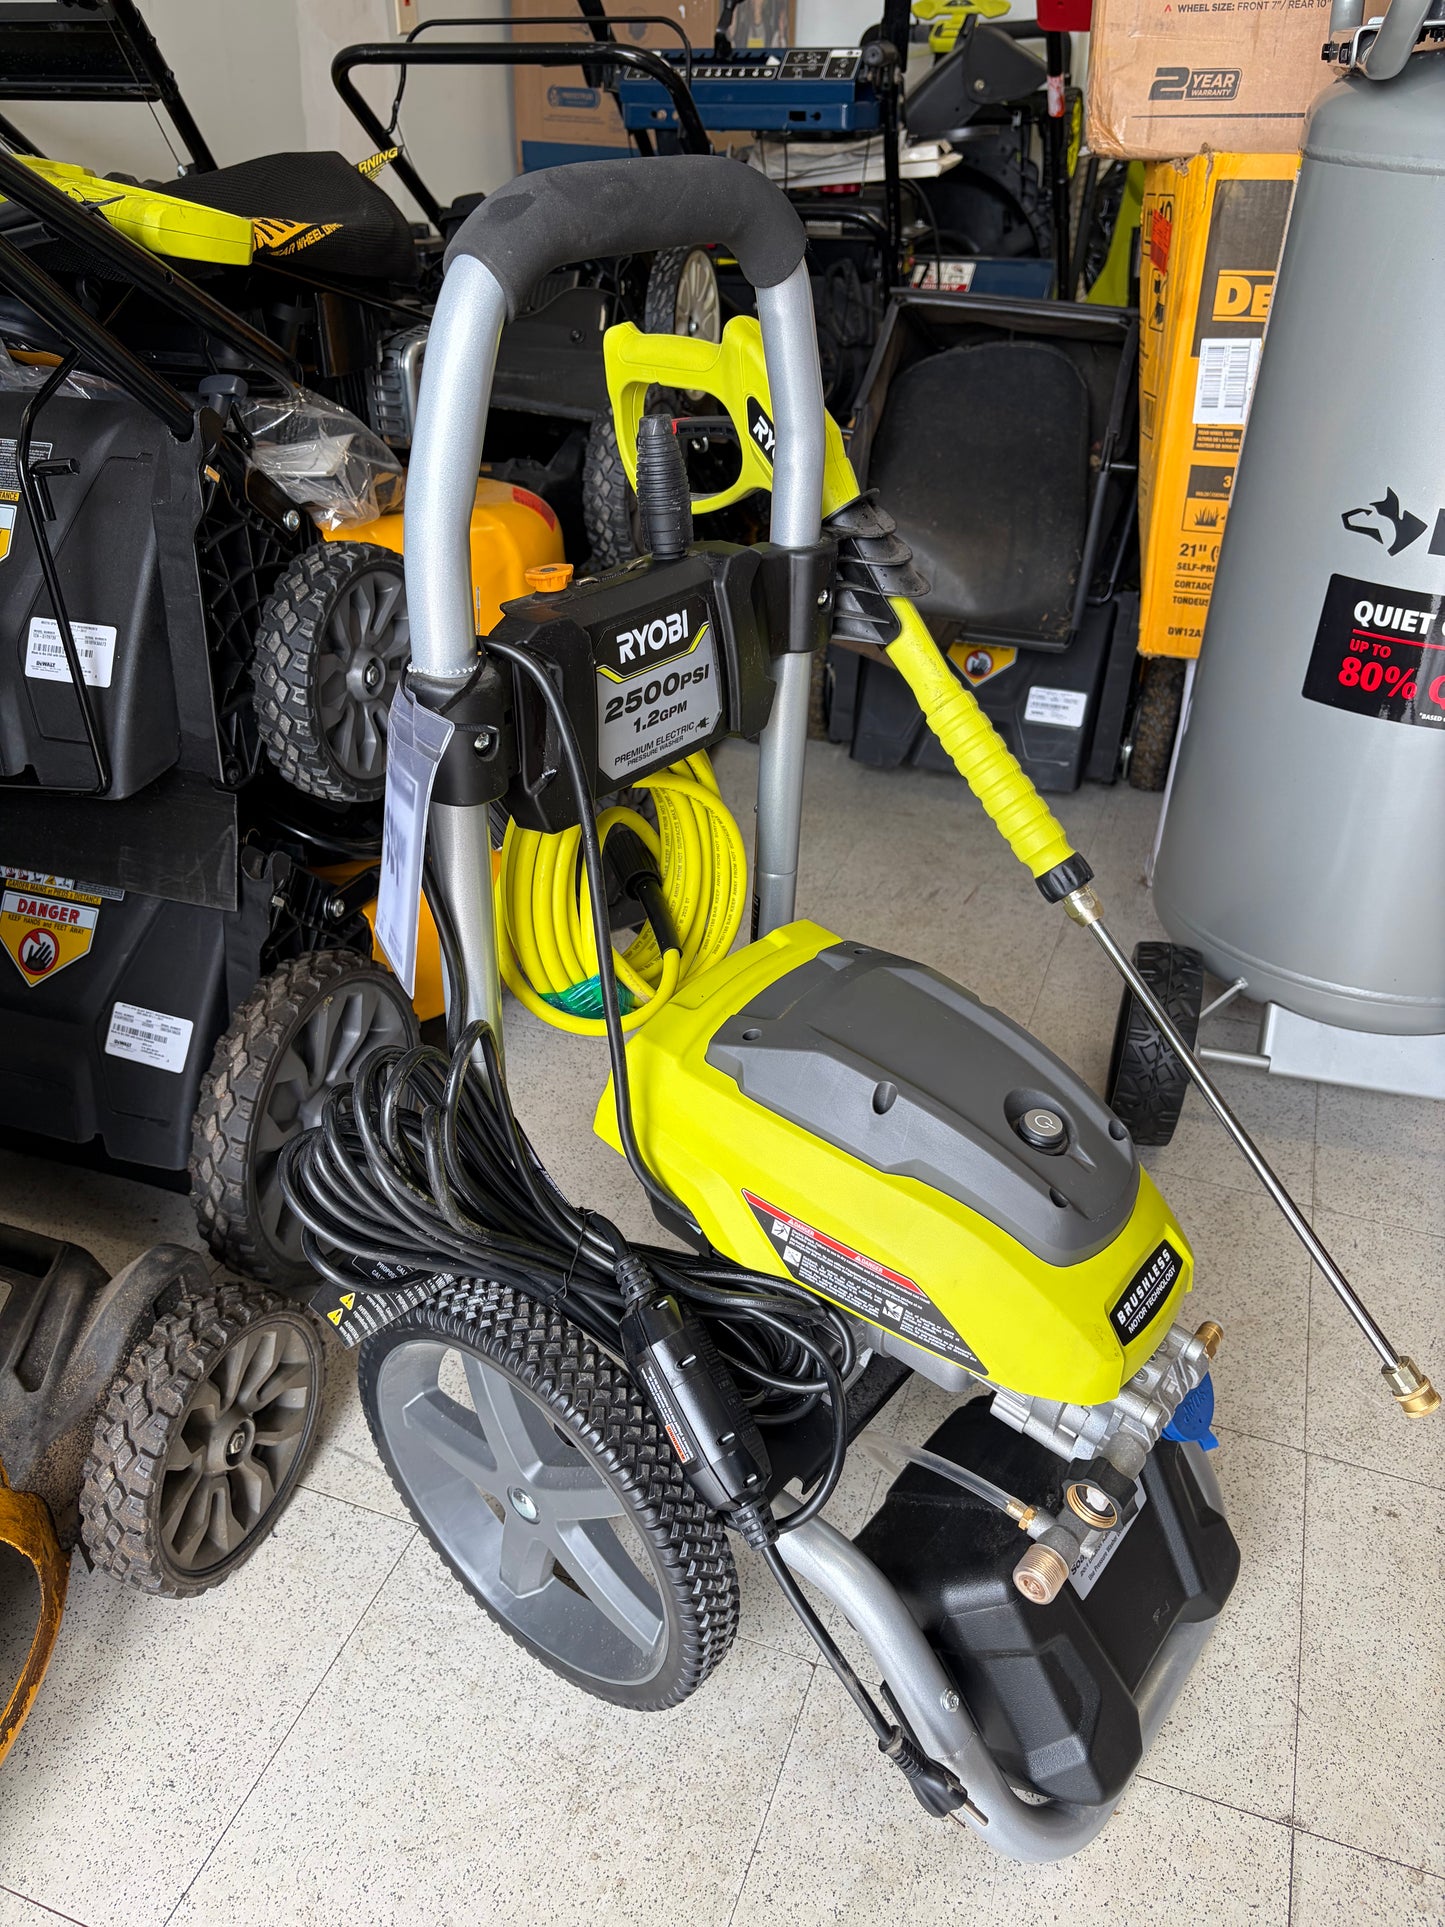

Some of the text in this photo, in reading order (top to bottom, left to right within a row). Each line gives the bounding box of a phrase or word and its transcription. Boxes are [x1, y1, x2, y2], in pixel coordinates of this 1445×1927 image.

[1178, 4, 1209, 14] WHEEL
[1212, 3, 1235, 12] SIZE:
[1237, 2, 1268, 11] FRONT
[1288, 0, 1314, 9] REAR
[1148, 67, 1236, 100] 2 YEAR
[1191, 89, 1232, 97] WARRANTY
[297, 228, 326, 250] WHEEL
[753, 416, 775, 459] RY
[1223, 476, 1232, 488] 3
[1179, 543, 1207, 558] 21"
[1354, 600, 1436, 635] QUIET
[616, 609, 689, 664] RYOBI
[1350, 639, 1391, 658] UP TO
[1338, 656, 1417, 699] 80%
[604, 664, 710, 724] 2500PSI
[633, 700, 687, 733] 1.2GPM
[614, 721, 695, 765] PREMIUM ELECTRIC
[627, 735, 684, 766] PRESSURE WASHER
[17, 898, 80, 924] DANGER
[23, 917, 40, 927] HANDS
[54, 923, 67, 931] FEET
[70, 926, 84, 935] AWAY
[793, 1222, 814, 1237] DANGER
[861, 1258, 883, 1274] DANGER
[1117, 1249, 1170, 1325] BRUSHLESS
[1128, 1264, 1176, 1334] MOTOR TECHNOLOGY
[1071, 1555, 1087, 1575] Soa
[1088, 1569, 1096, 1581] Use
[1094, 1552, 1108, 1573] Pressure
